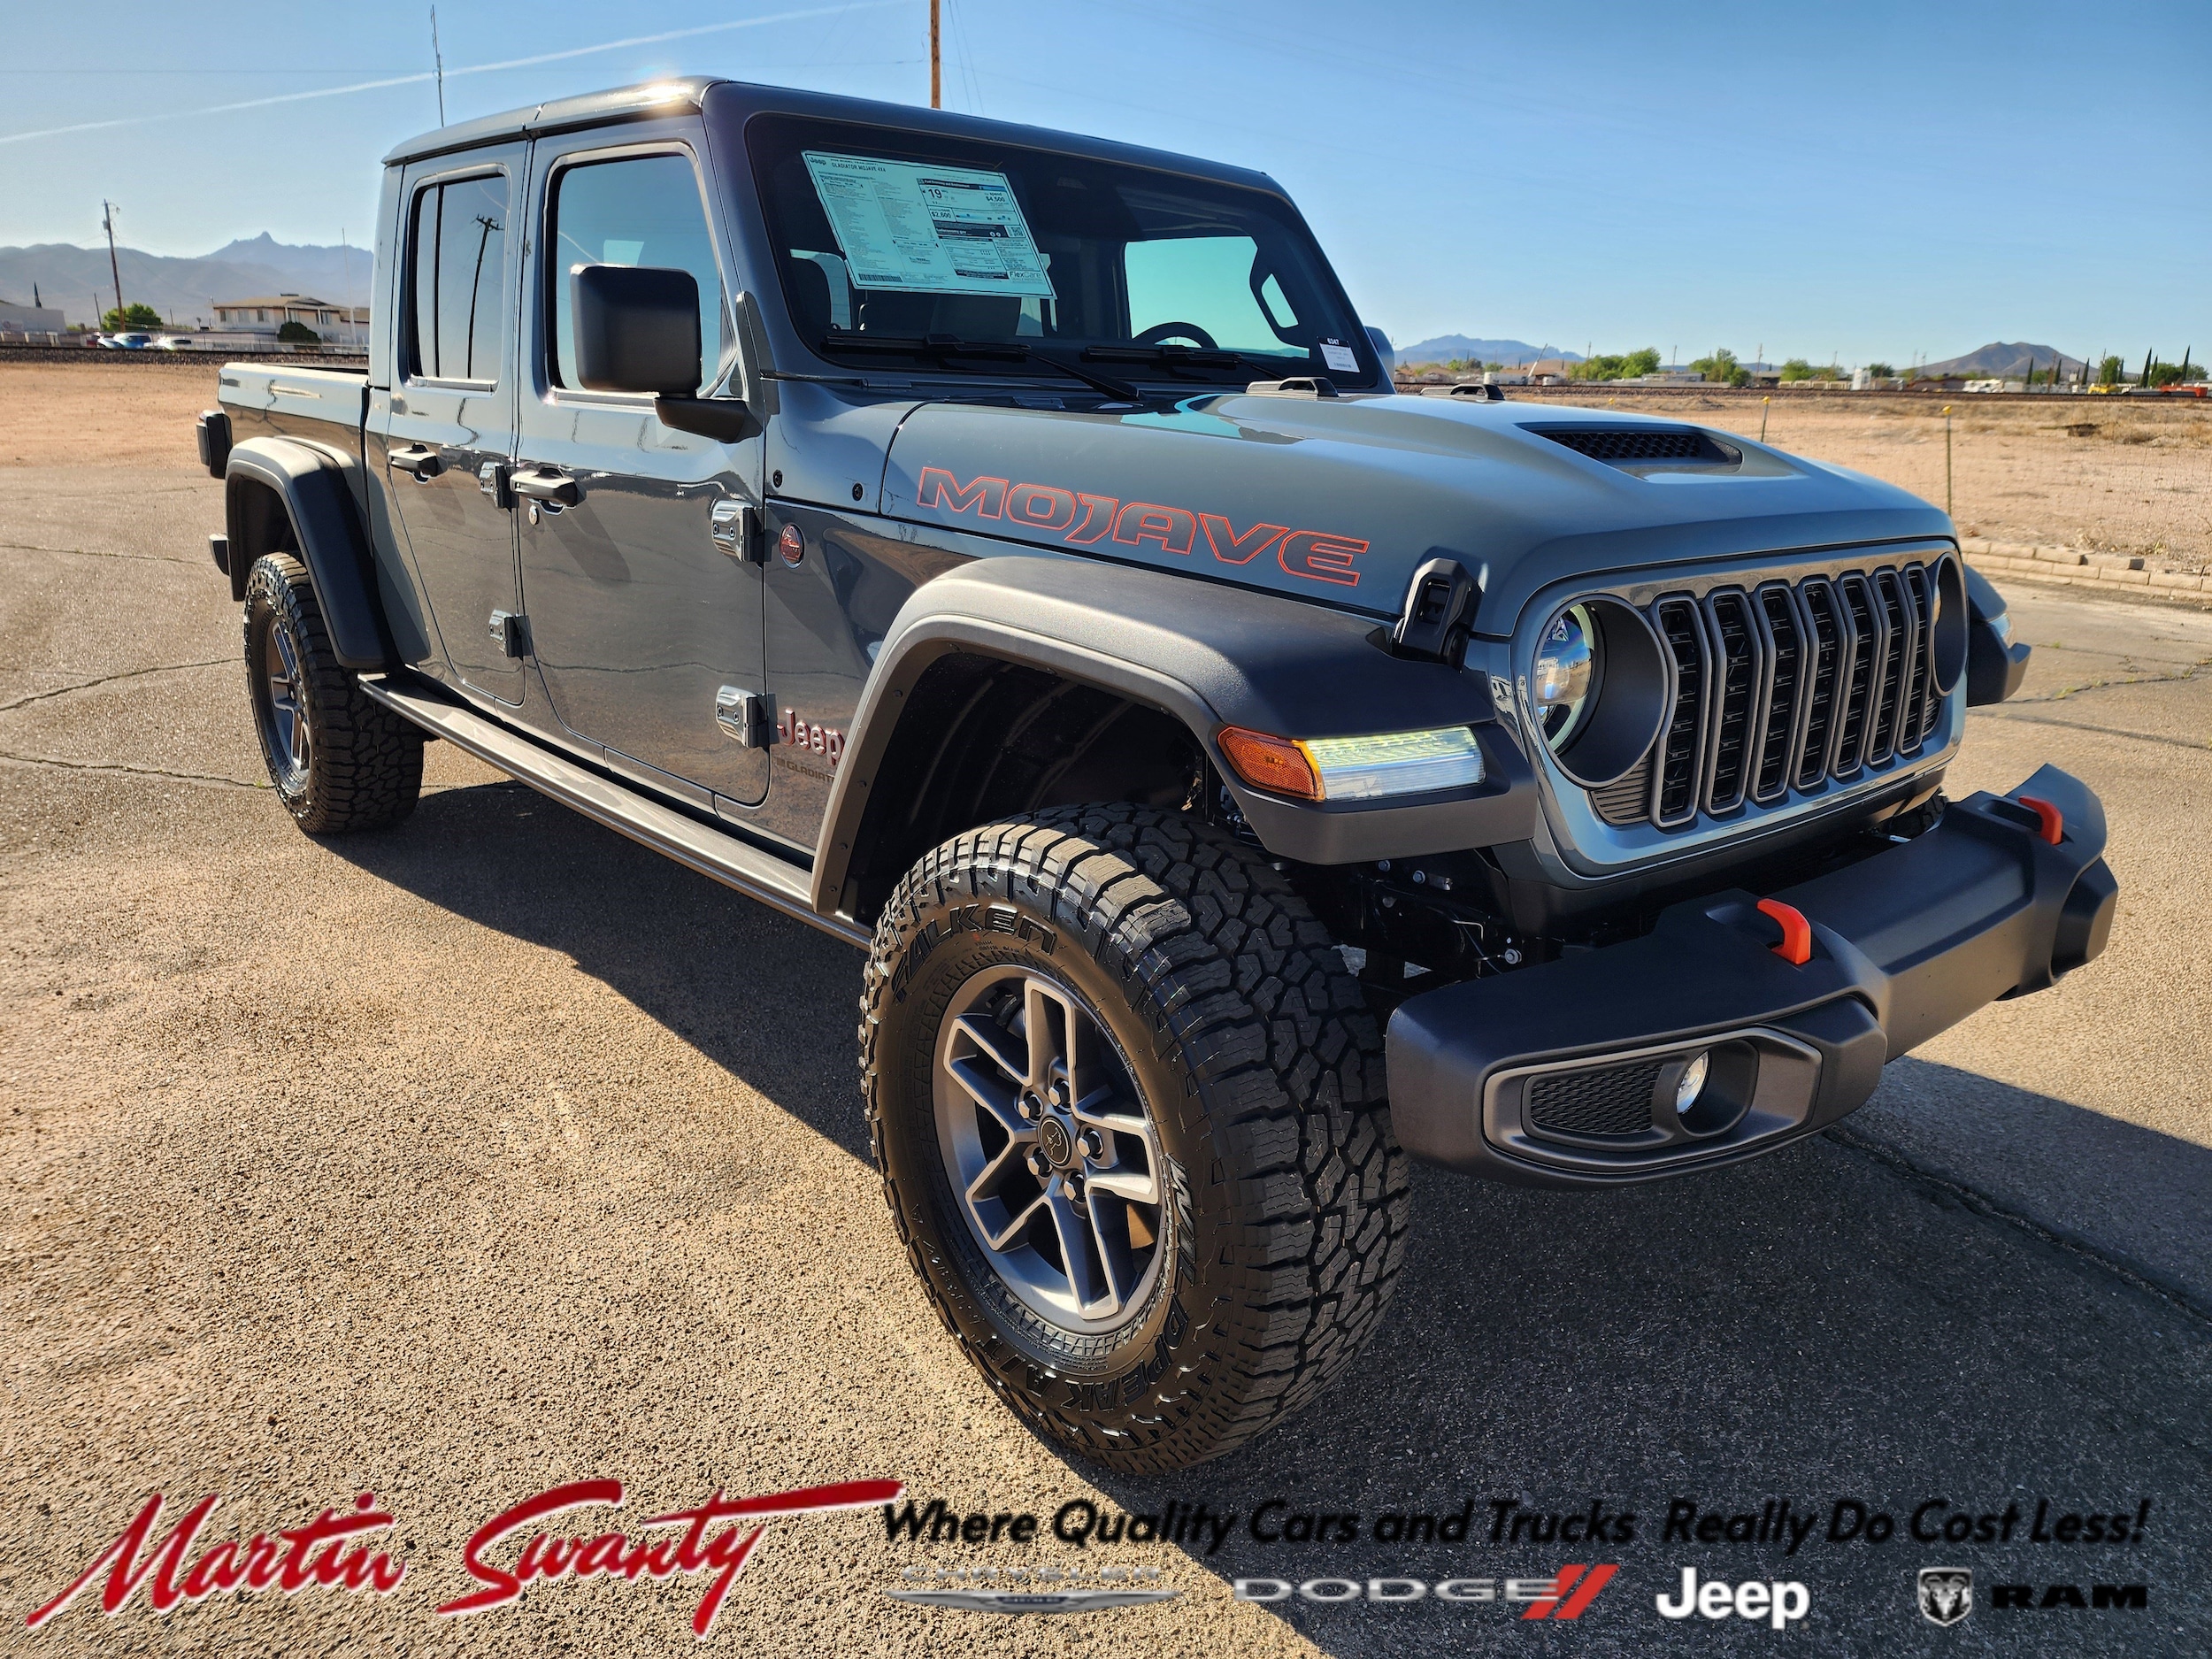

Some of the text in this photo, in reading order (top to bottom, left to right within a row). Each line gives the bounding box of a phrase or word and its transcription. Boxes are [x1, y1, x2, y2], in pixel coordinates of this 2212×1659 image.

[928, 188, 942, 199] 19
[917, 466, 1371, 588] MOJAVE
[776, 709, 845, 766] Jeep
[787, 761, 835, 783] GLADIAT
[891, 902, 1057, 1005] FALKEN
